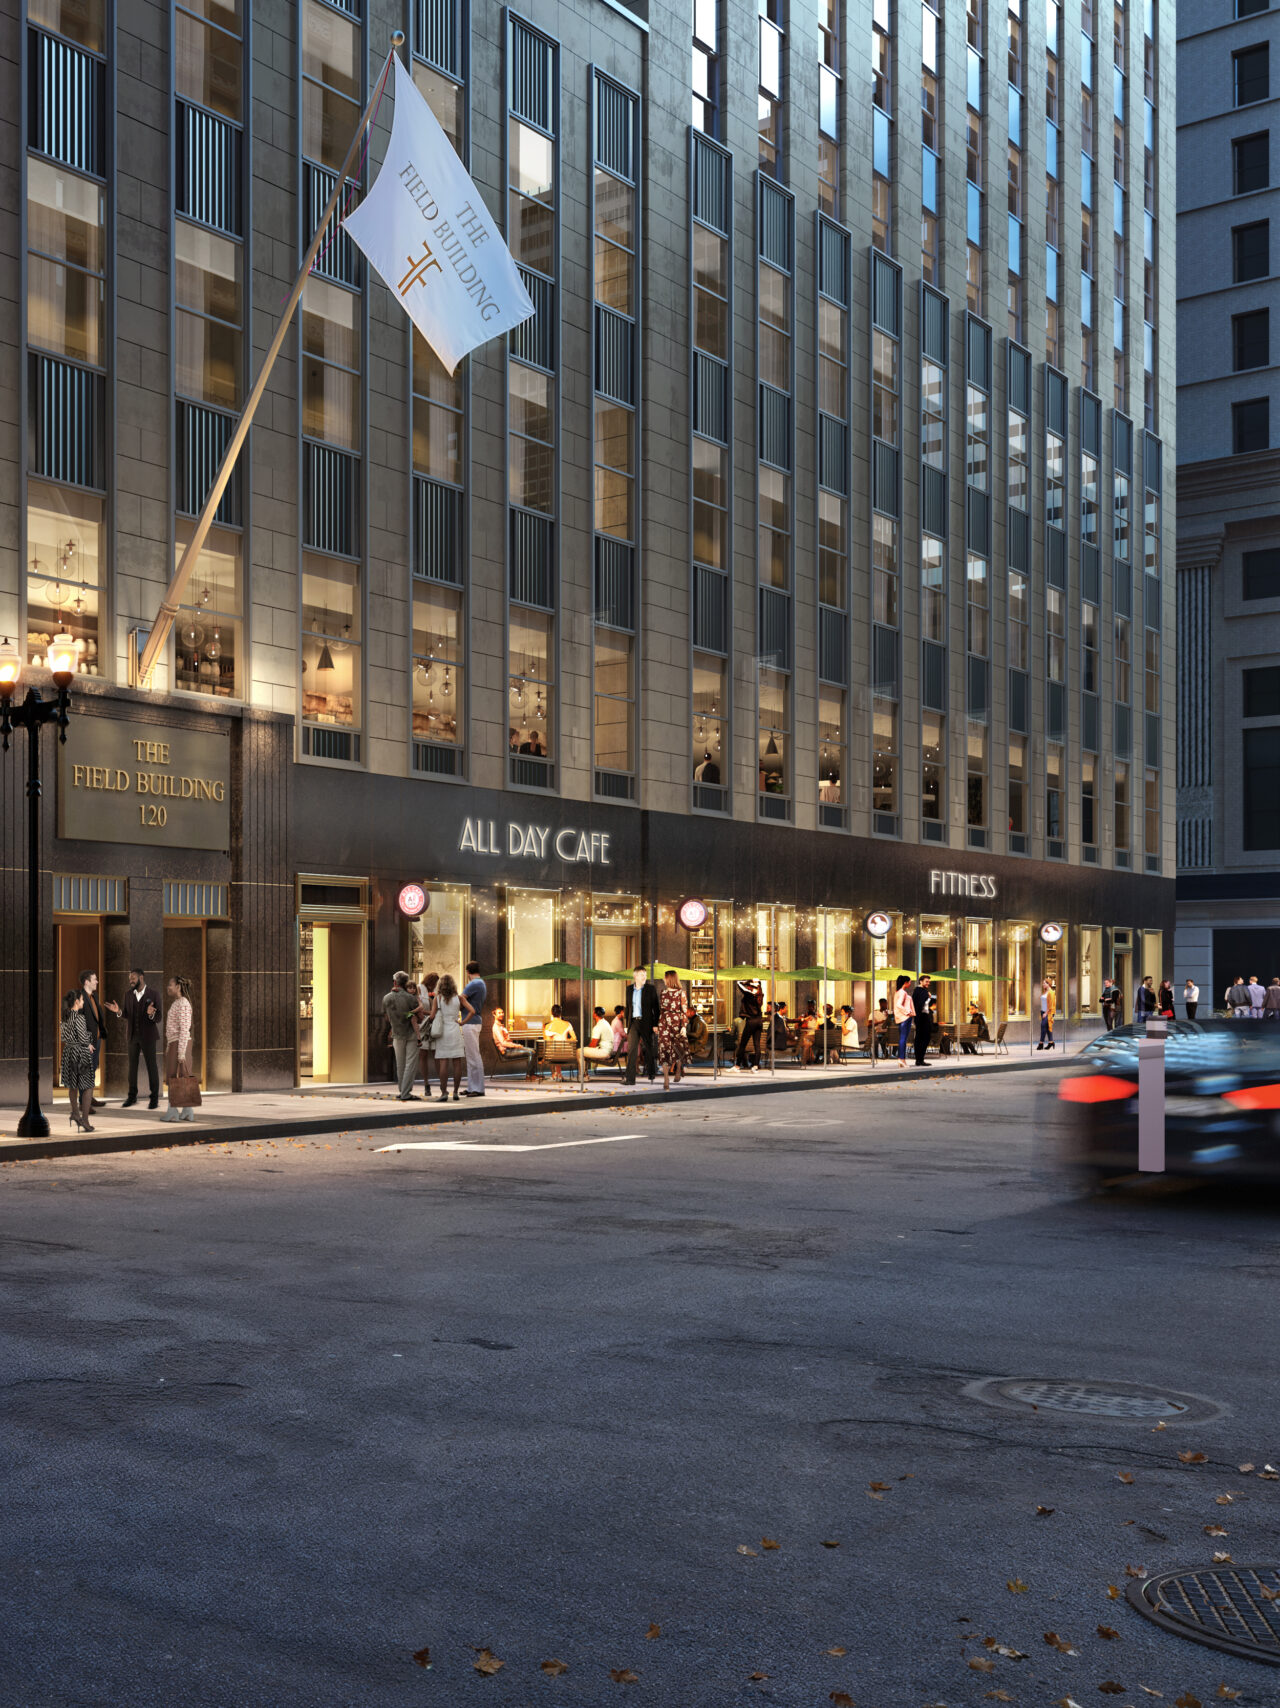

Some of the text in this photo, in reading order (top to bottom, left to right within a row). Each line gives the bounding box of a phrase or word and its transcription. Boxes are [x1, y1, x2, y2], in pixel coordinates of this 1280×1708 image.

[399, 160, 501, 322] FIELD BUILDING
[456, 201, 490, 248] THE
[133, 739, 171, 764] THE
[72, 764, 226, 802] FIELD BUILDING
[139, 804, 167, 827] 120
[460, 818, 610, 864] ALL DAY CAFE
[931, 870, 996, 898] FITNESS
